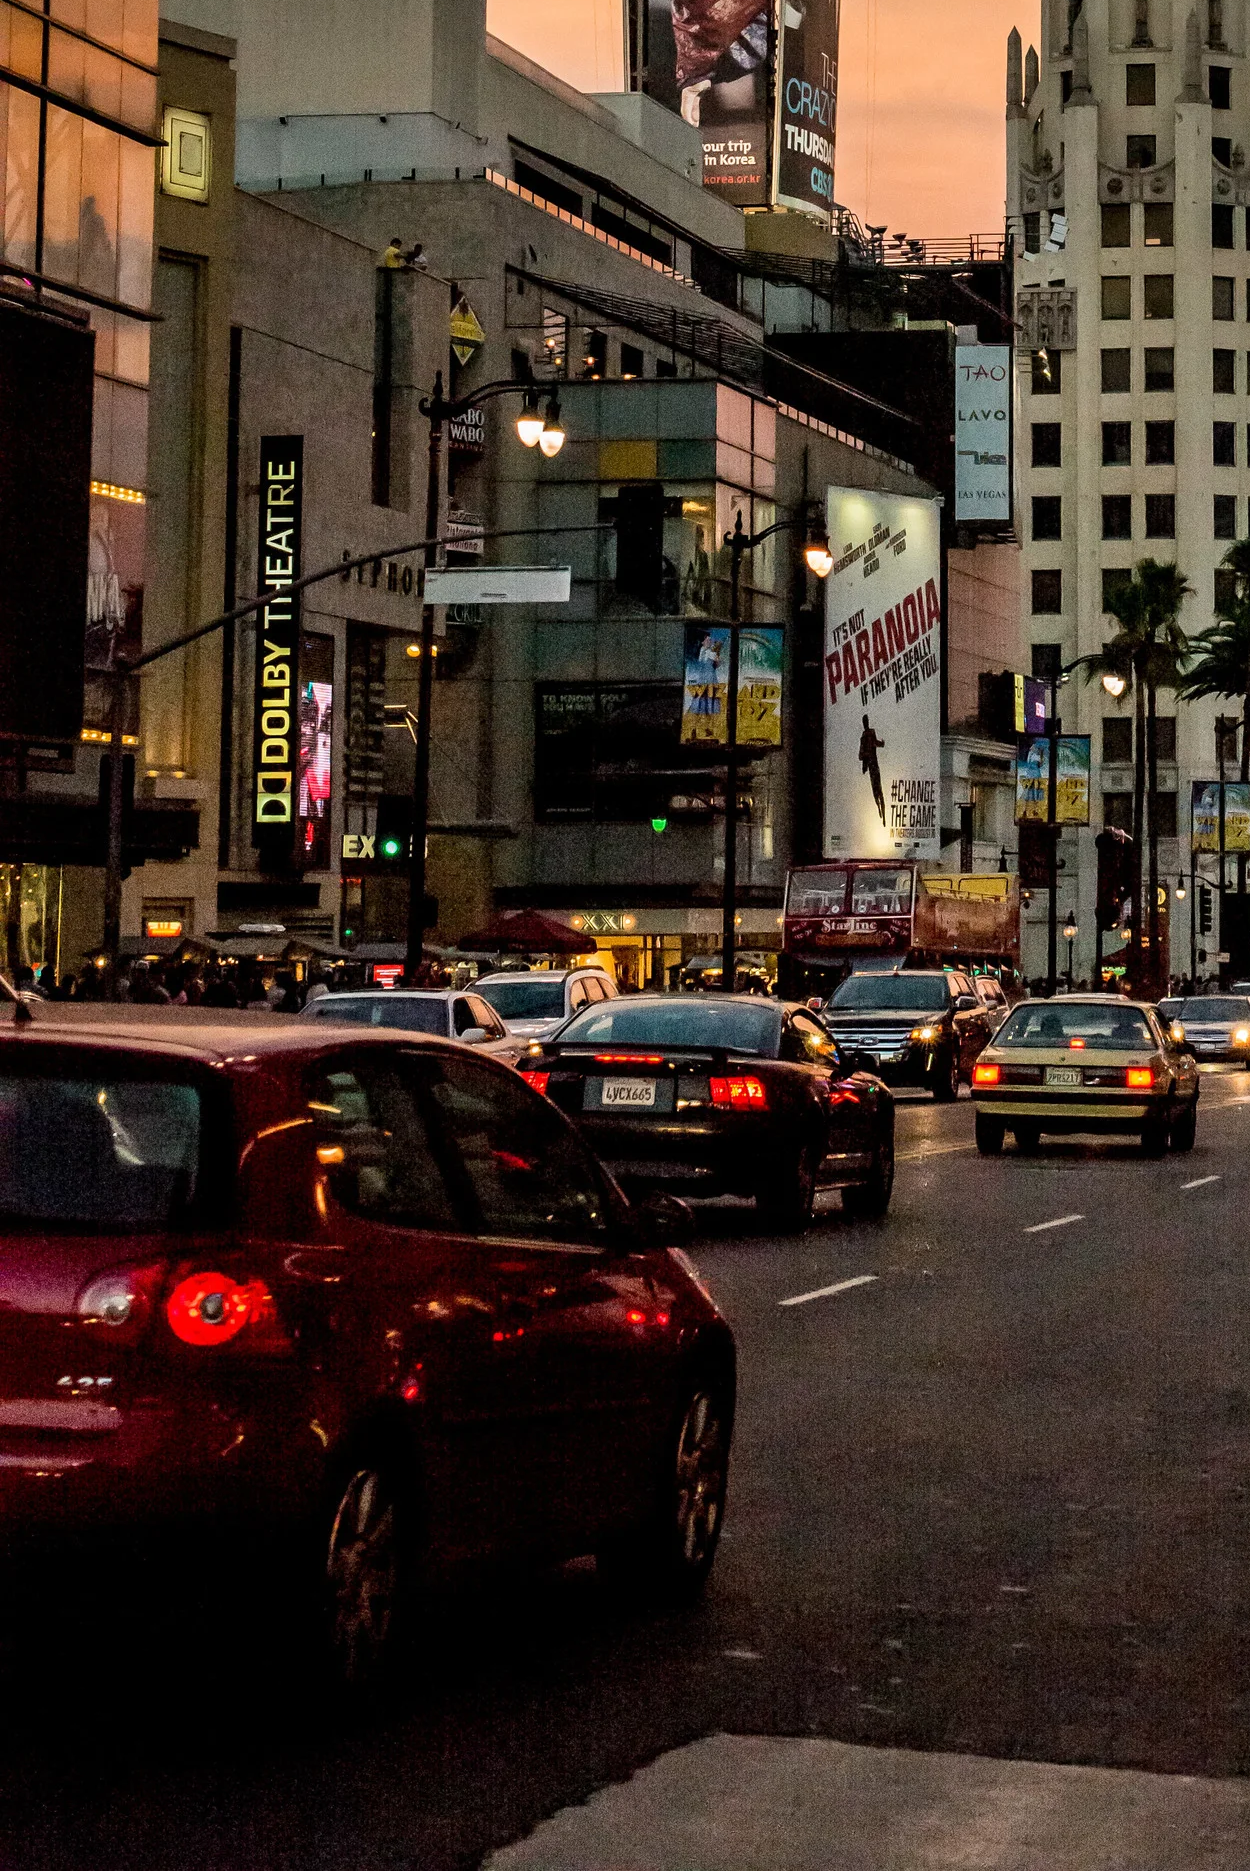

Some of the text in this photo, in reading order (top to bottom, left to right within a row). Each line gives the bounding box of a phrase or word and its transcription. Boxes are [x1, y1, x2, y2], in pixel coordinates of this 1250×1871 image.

[727, 140, 752, 154] trip
[705, 153, 757, 166] in Korea
[959, 364, 1006, 382] TAO
[958, 409, 1007, 422] LAVO
[451, 423, 485, 443] WABO
[958, 489, 1007, 500] LAS VEGAS
[261, 460, 296, 765] THEATRE DOLBY
[833, 608, 865, 648] IT'S NOT
[825, 577, 941, 706] PARANOIA
[860, 634, 932, 707] IF THEY'RE REALLY
[895, 666, 921, 704] AFTER
[891, 779, 936, 803] #CHANGE
[890, 804, 937, 828] THE GAME
[581, 913, 624, 931] XXI
